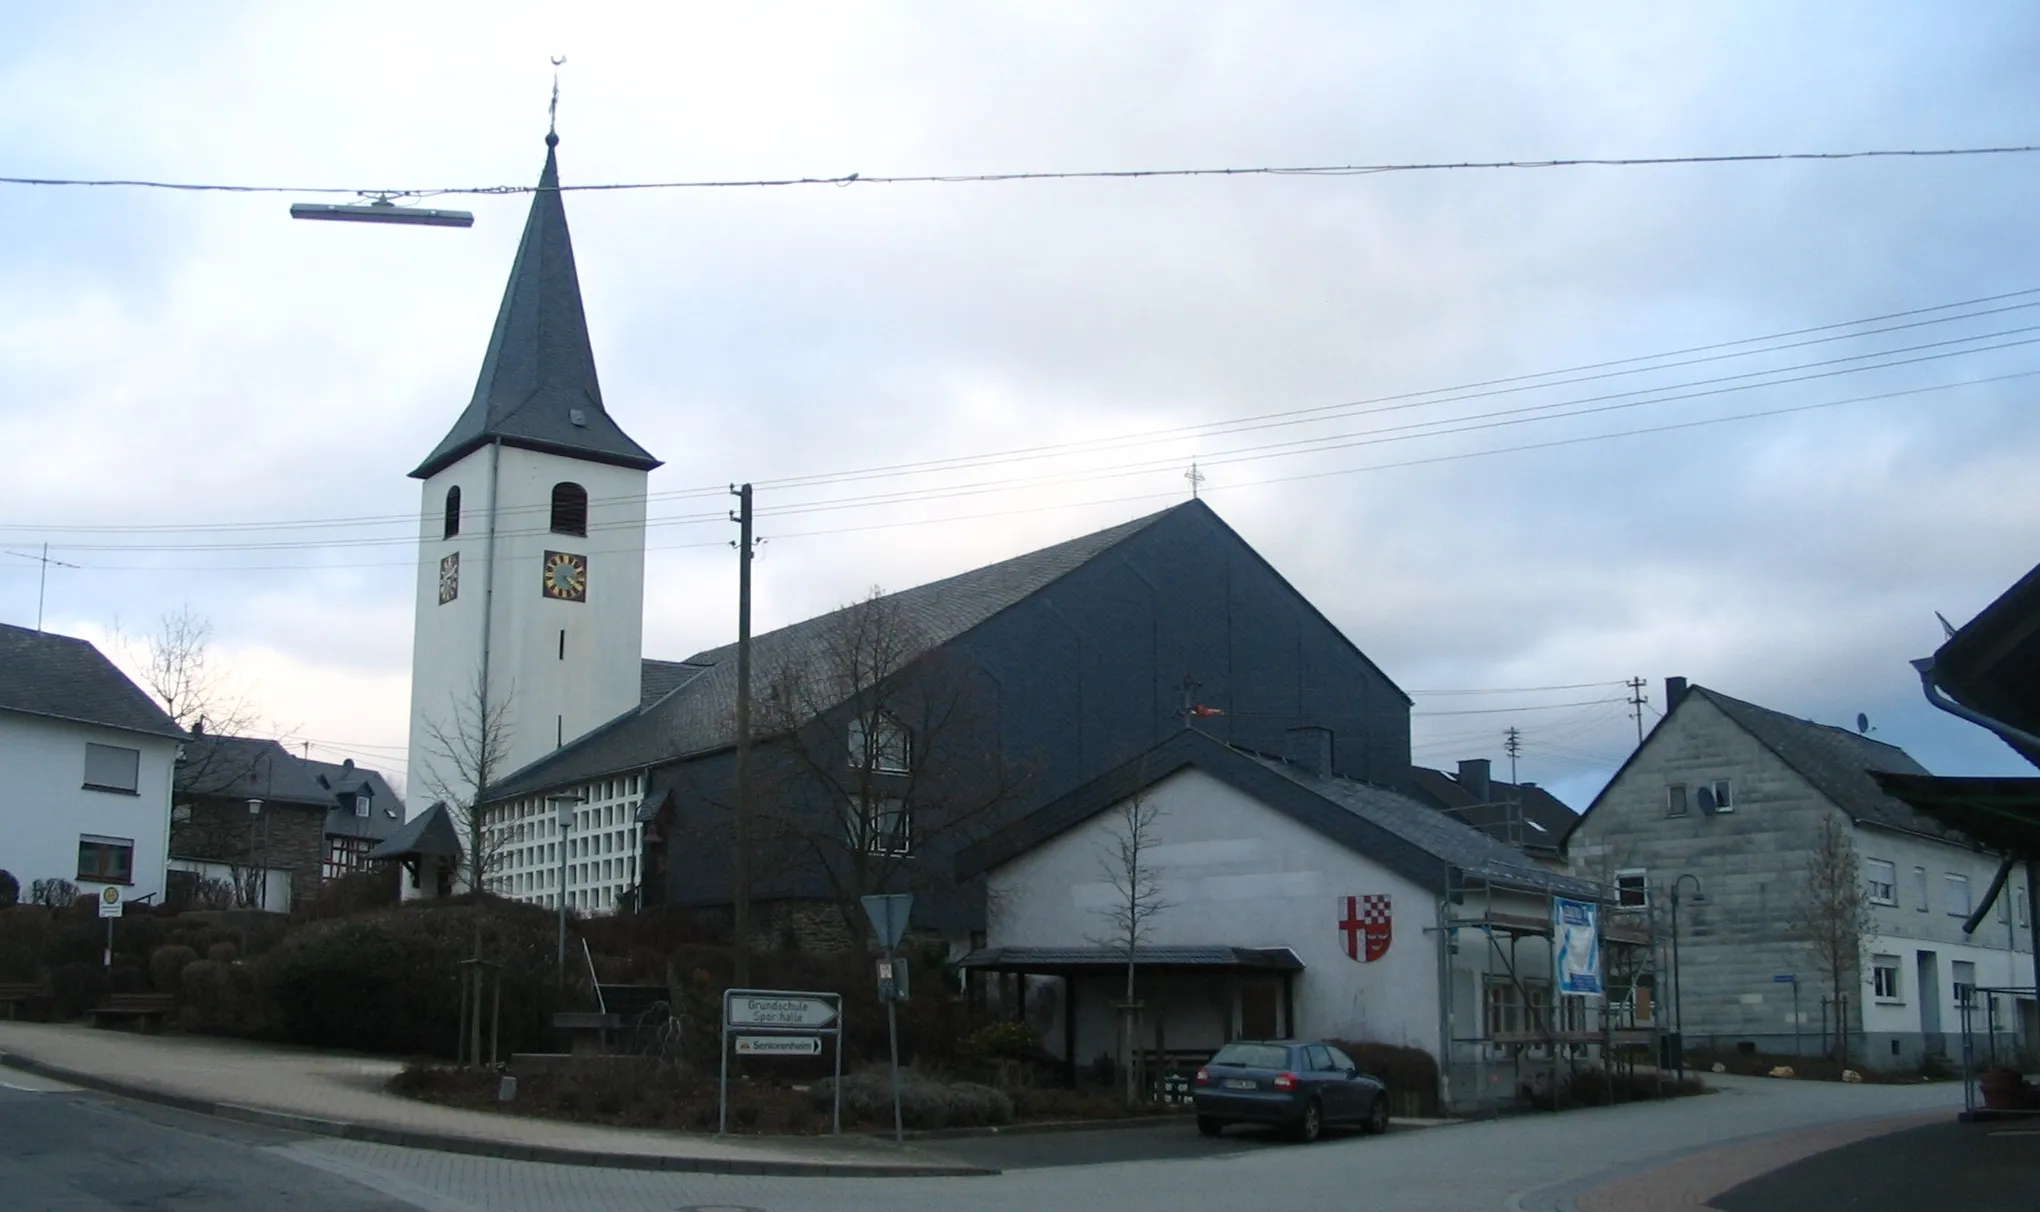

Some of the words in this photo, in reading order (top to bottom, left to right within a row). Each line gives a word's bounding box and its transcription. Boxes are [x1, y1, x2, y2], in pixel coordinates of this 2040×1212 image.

[748, 1000, 808, 1011] Grundschule
[753, 1012, 803, 1022] Sporhalle
[753, 1040, 811, 1050] Seniorenheim
